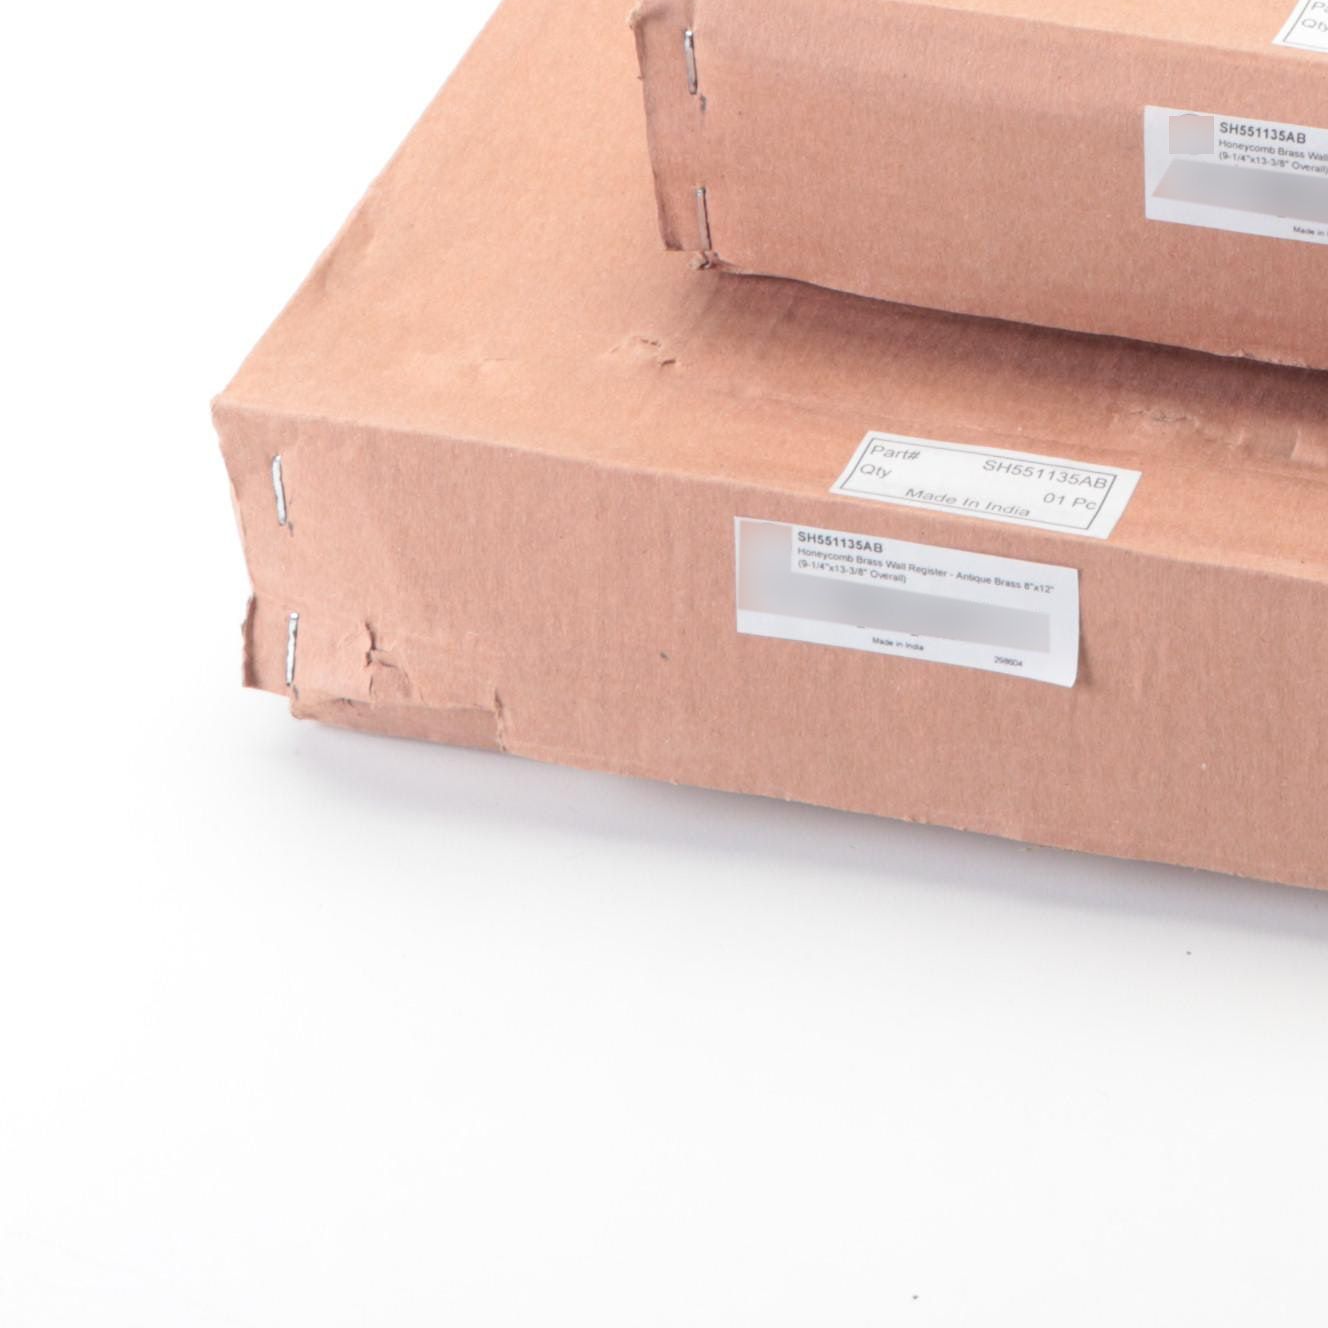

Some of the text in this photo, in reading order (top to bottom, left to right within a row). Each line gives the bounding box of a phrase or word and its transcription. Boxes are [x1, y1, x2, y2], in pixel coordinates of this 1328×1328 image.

[1219, 121, 1307, 144] SH551135AB
[1218, 139, 1276, 155] Honeycomb
[1277, 146, 1305, 159] Brass
[1307, 151, 1328, 162] Wall
[1291, 160, 1328, 175] Overall)
[1293, 225, 1315, 236] Made
[869, 444, 1109, 489] Part# SH551135AB
[859, 463, 1098, 511] Qty 01 Pc
[904, 487, 1031, 518] Made In India
[797, 531, 884, 553] SH551135AB
[797, 547, 854, 563] Honeycomb
[856, 555, 883, 567] Brass
[885, 560, 907, 570] Wall
[908, 563, 947, 577] Register
[955, 571, 992, 584] Antique
[994, 577, 1021, 589] Brass
[870, 569, 907, 584] Overall)
[872, 636, 894, 646] Made
[905, 641, 925, 651] India
